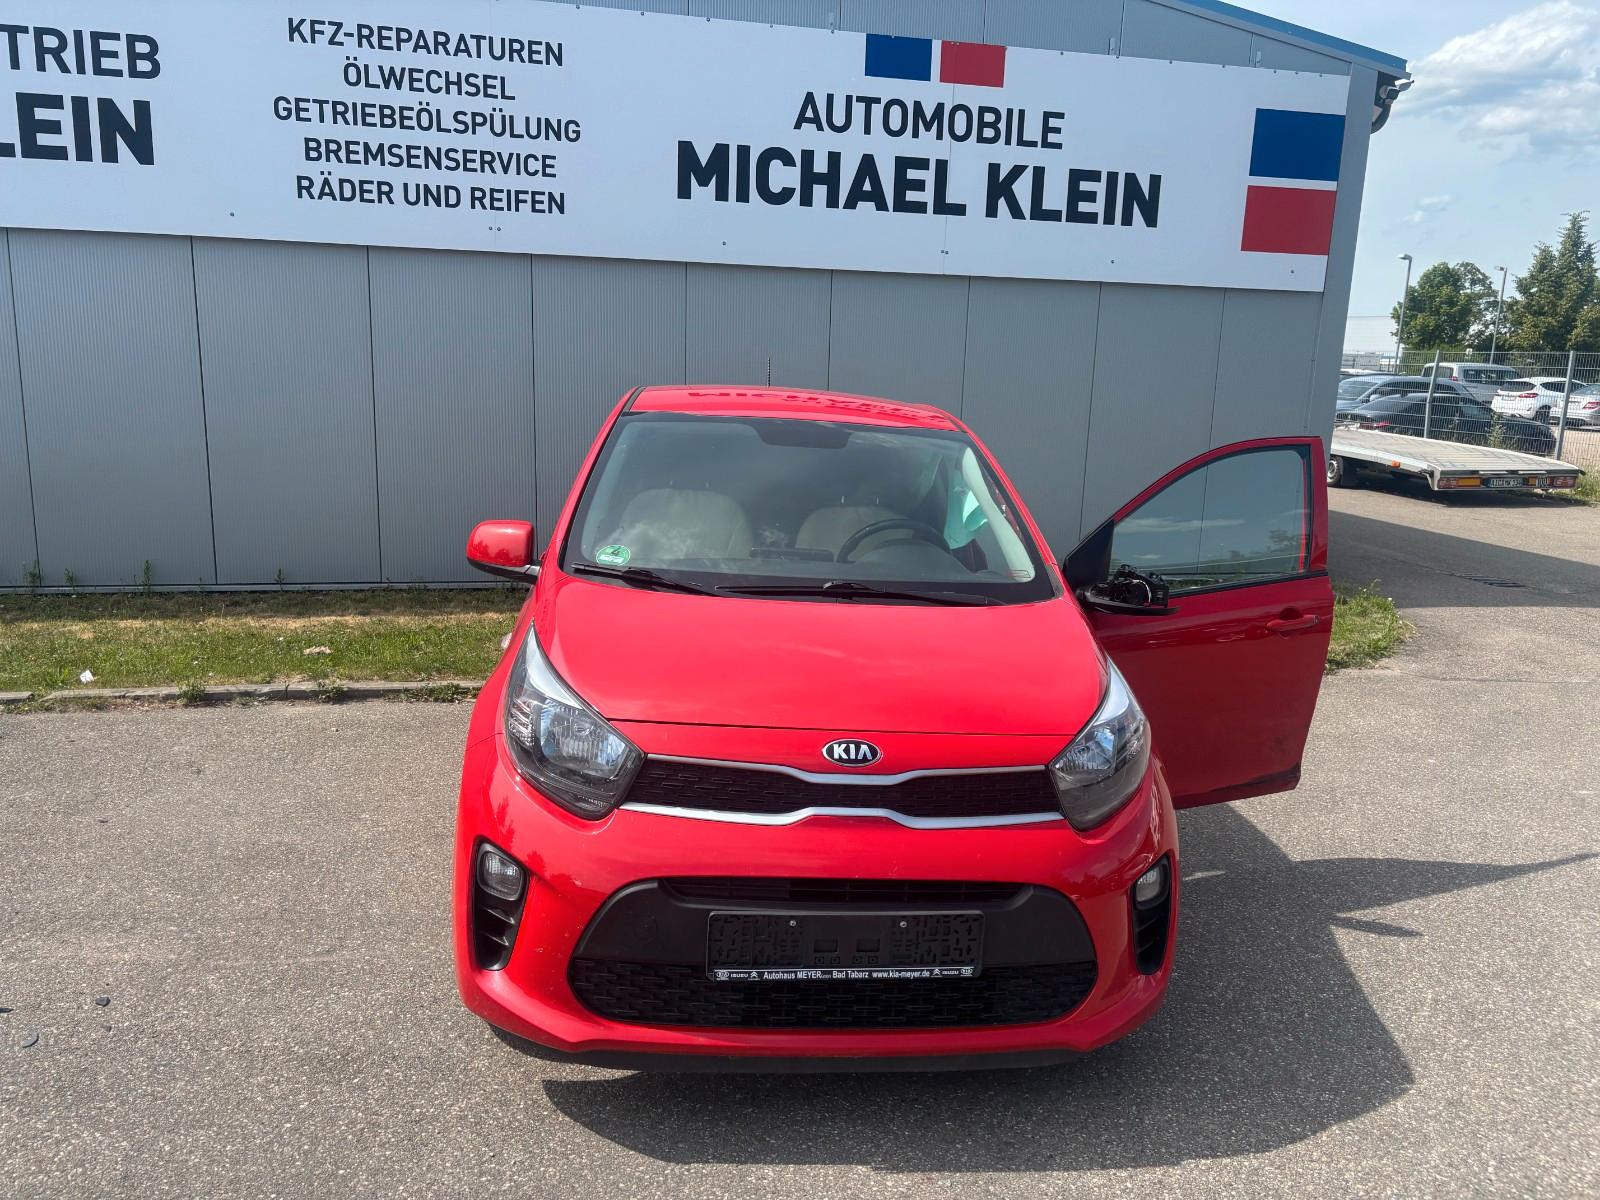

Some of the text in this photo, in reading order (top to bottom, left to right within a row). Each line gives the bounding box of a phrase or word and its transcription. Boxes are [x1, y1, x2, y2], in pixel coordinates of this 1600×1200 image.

[0, 23, 161, 80] TRIEB
[287, 17, 563, 67] KFZ-REPARATUREN
[343, 55, 516, 101] ÖLWECHSEL
[273, 95, 582, 143] GETRIEBEÖLSPÜLUNG
[792, 91, 1066, 150] AUTOMOBILE
[303, 137, 558, 178] BREMSENSERVICE
[296, 171, 565, 215] RÄDER UND REIFEN
[677, 140, 1162, 229] MICHAEL KLEIN
[832, 743, 873, 760] KIA
[763, 971, 796, 980] Autohaus
[796, 970, 822, 979] MEYER
[832, 970, 846, 979] Bad
[847, 970, 869, 979] Tabarz
[871, 969, 930, 980] www.kia-meyer.de
